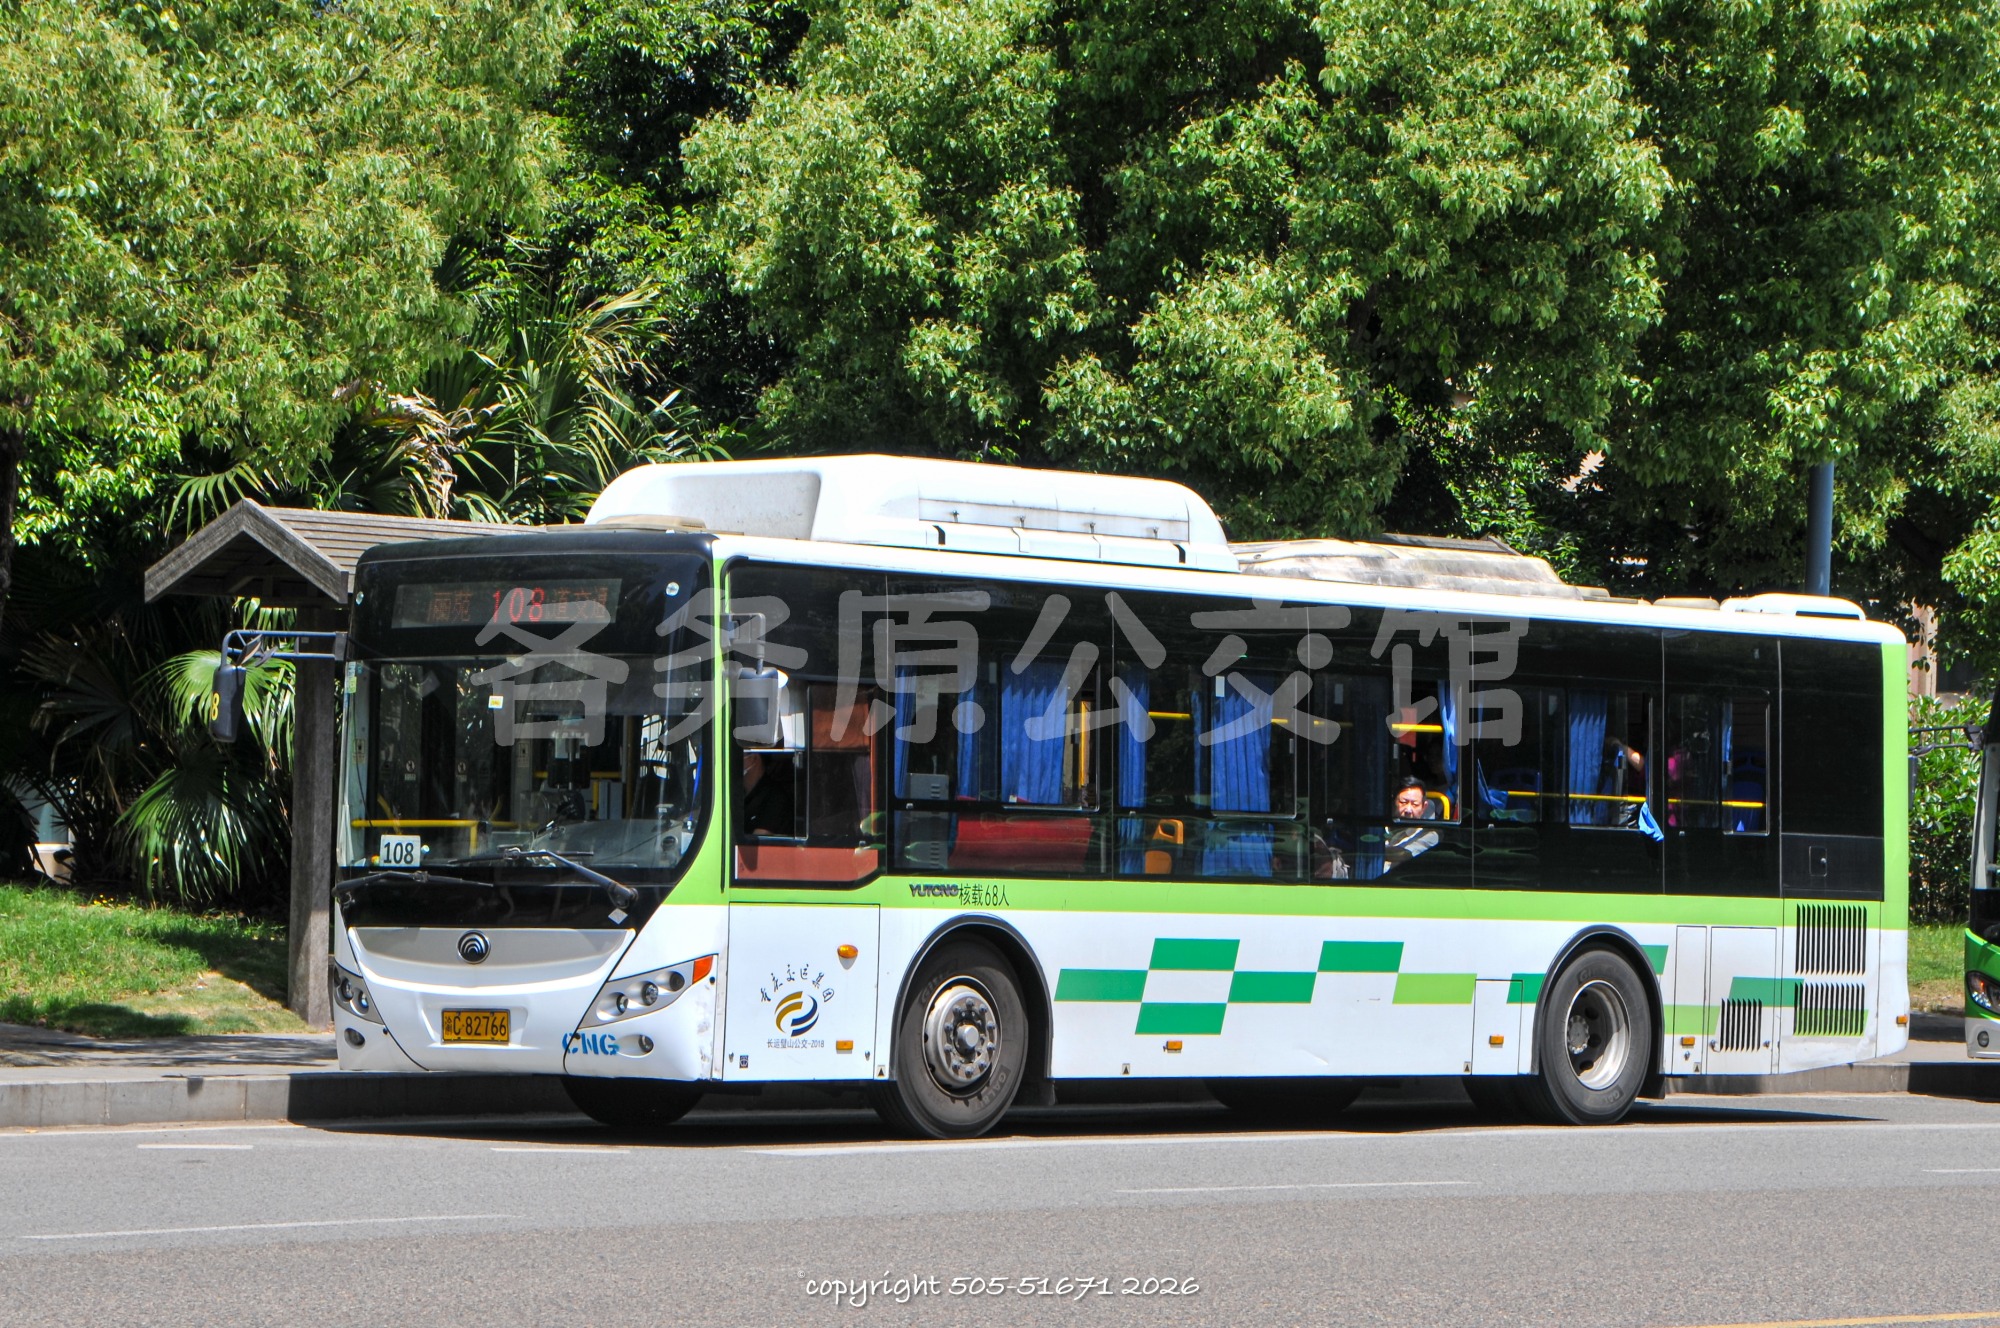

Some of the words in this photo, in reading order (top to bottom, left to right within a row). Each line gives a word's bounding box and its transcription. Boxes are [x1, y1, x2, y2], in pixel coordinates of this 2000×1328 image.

[492, 587, 546, 624] 108
[382, 841, 415, 866] 108
[908, 883, 960, 898] YUTONG
[957, 882, 1010, 907] 核载68人
[562, 1032, 620, 1056] CNG
